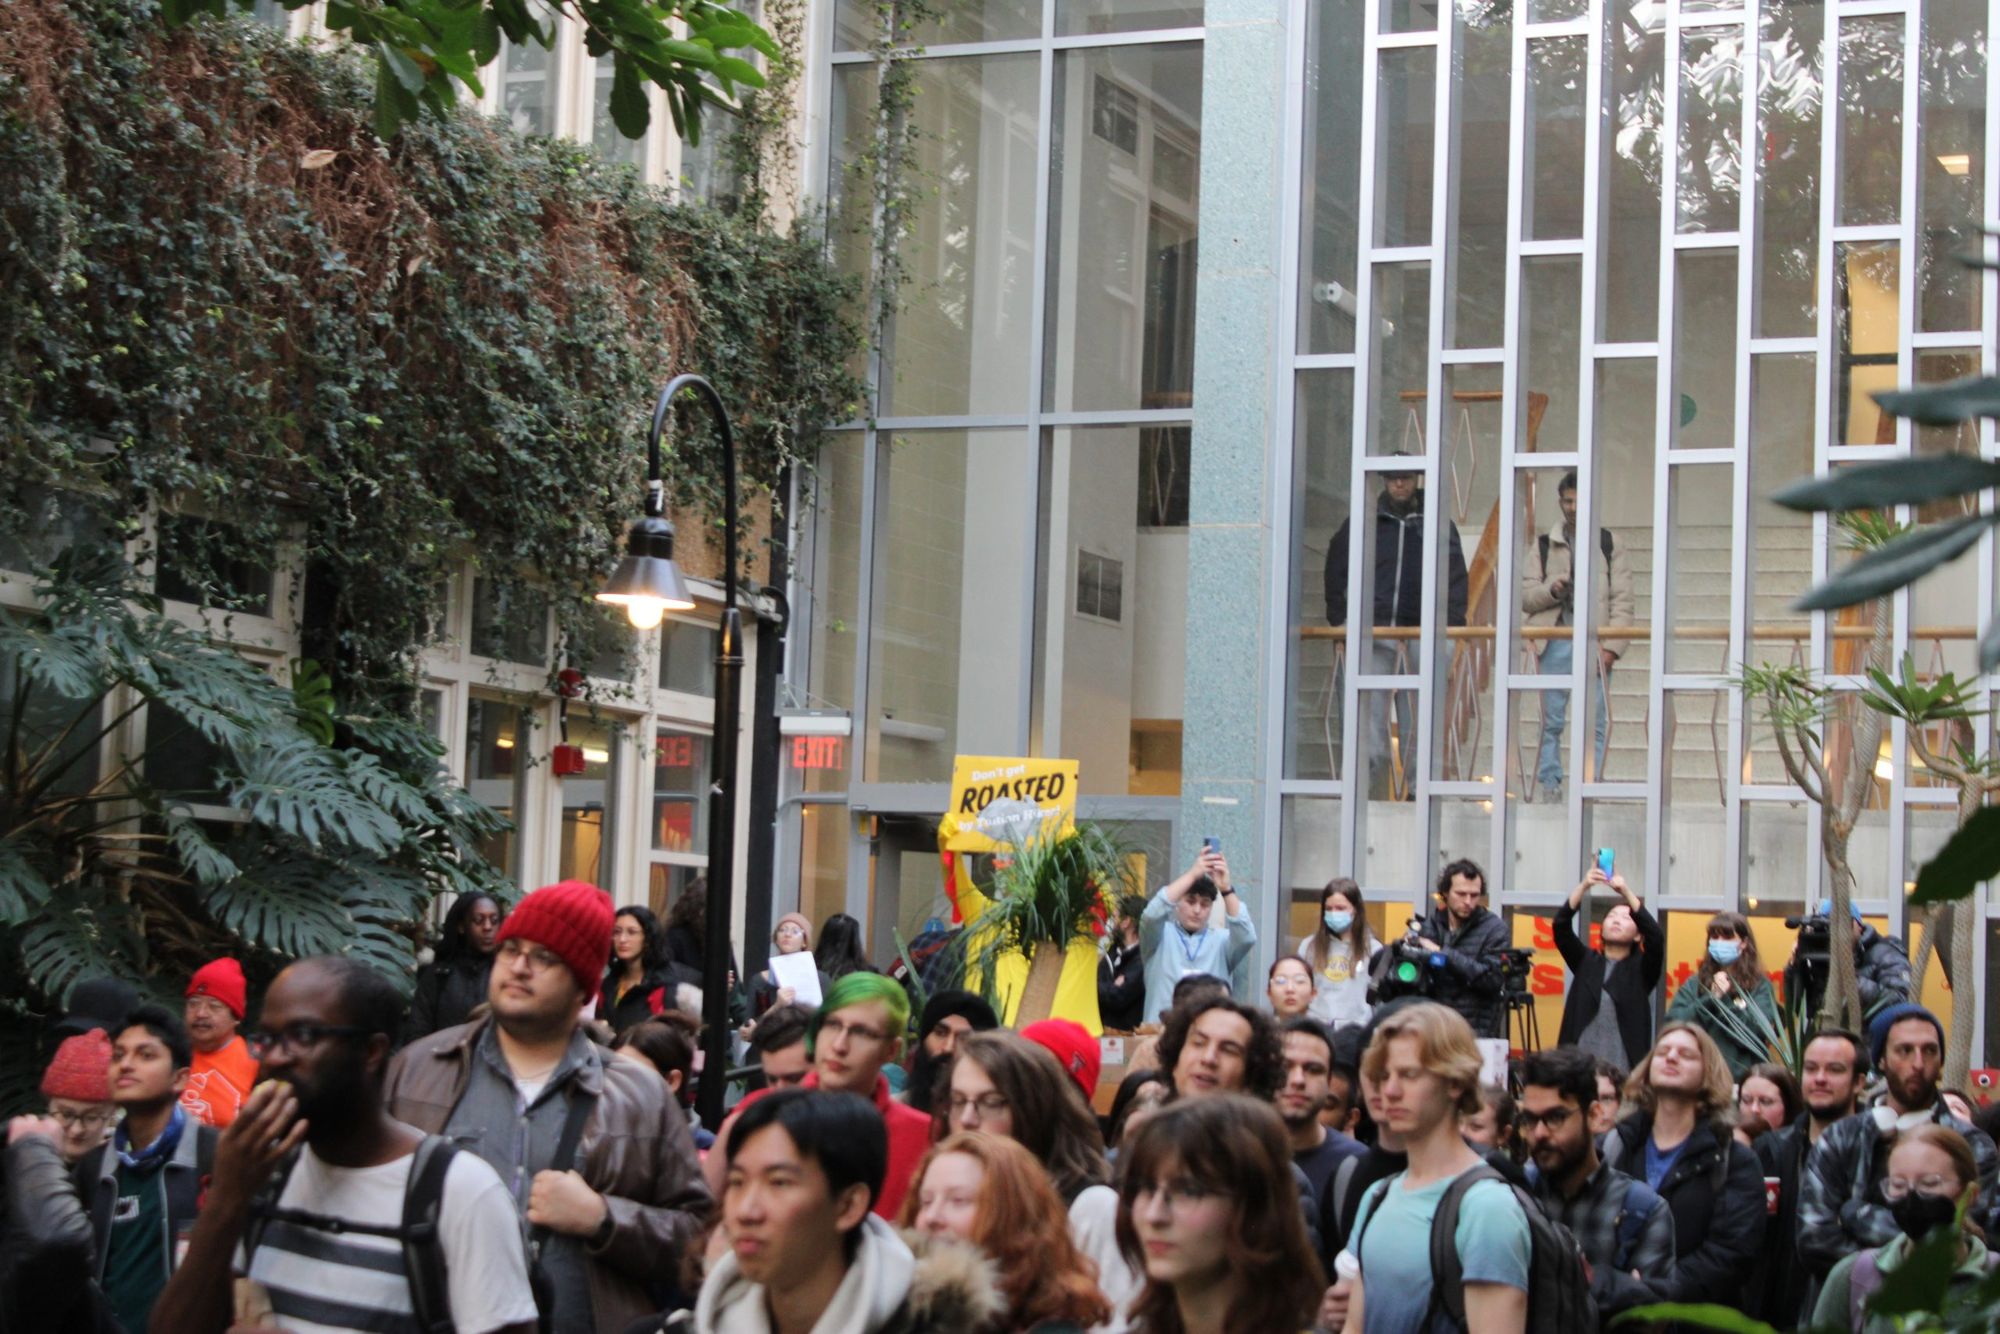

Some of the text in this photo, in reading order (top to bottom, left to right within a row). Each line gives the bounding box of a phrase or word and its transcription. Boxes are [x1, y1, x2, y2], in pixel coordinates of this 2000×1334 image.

[793, 736, 836, 768] EXIT
[972, 765, 1024, 781] Don't get
[960, 773, 1064, 813] ROASTED
